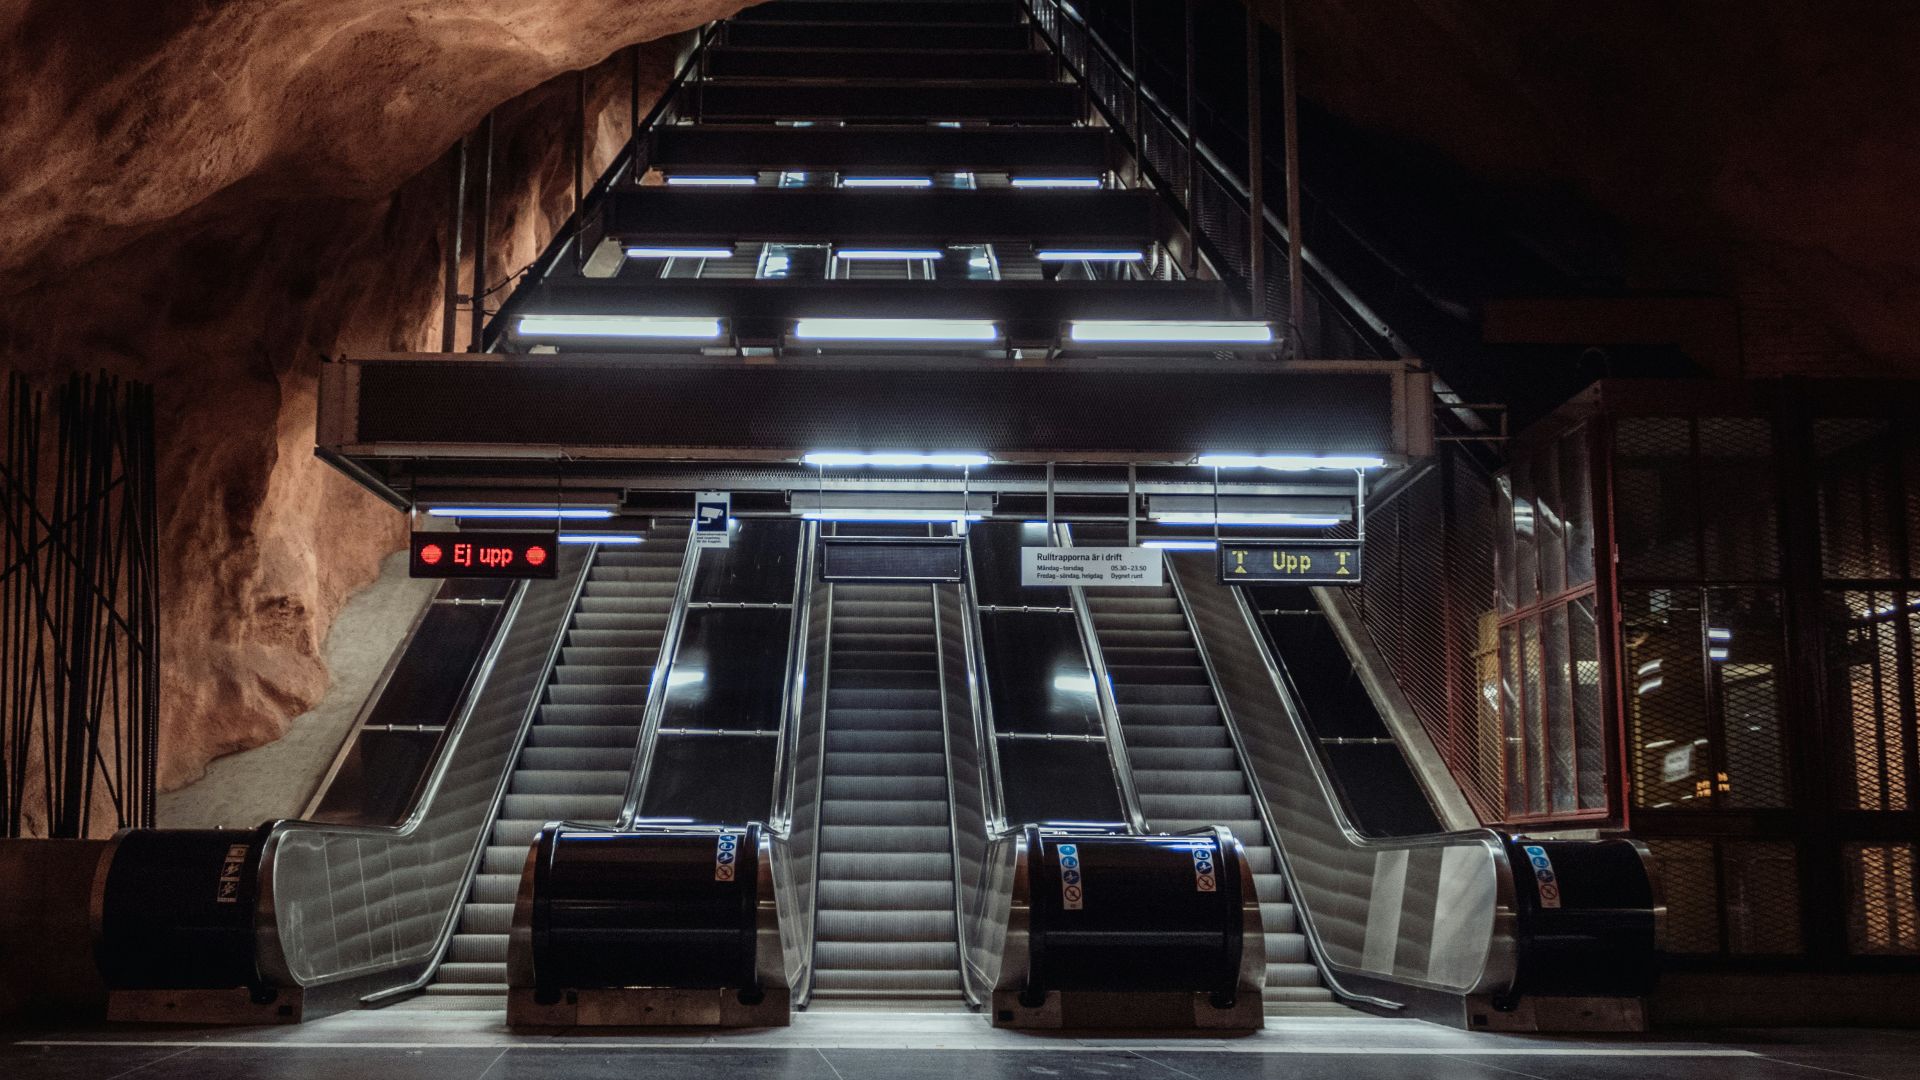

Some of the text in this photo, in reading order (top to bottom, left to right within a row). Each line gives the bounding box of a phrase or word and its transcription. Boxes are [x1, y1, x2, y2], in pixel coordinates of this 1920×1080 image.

[453, 544, 514, 568] Ej upp
[1037, 553, 1090, 562] Rulltrapporna
[1091, 553, 1100, 561] är
[1105, 553, 1122, 561] drift
[1273, 551, 1312, 574] Upp
